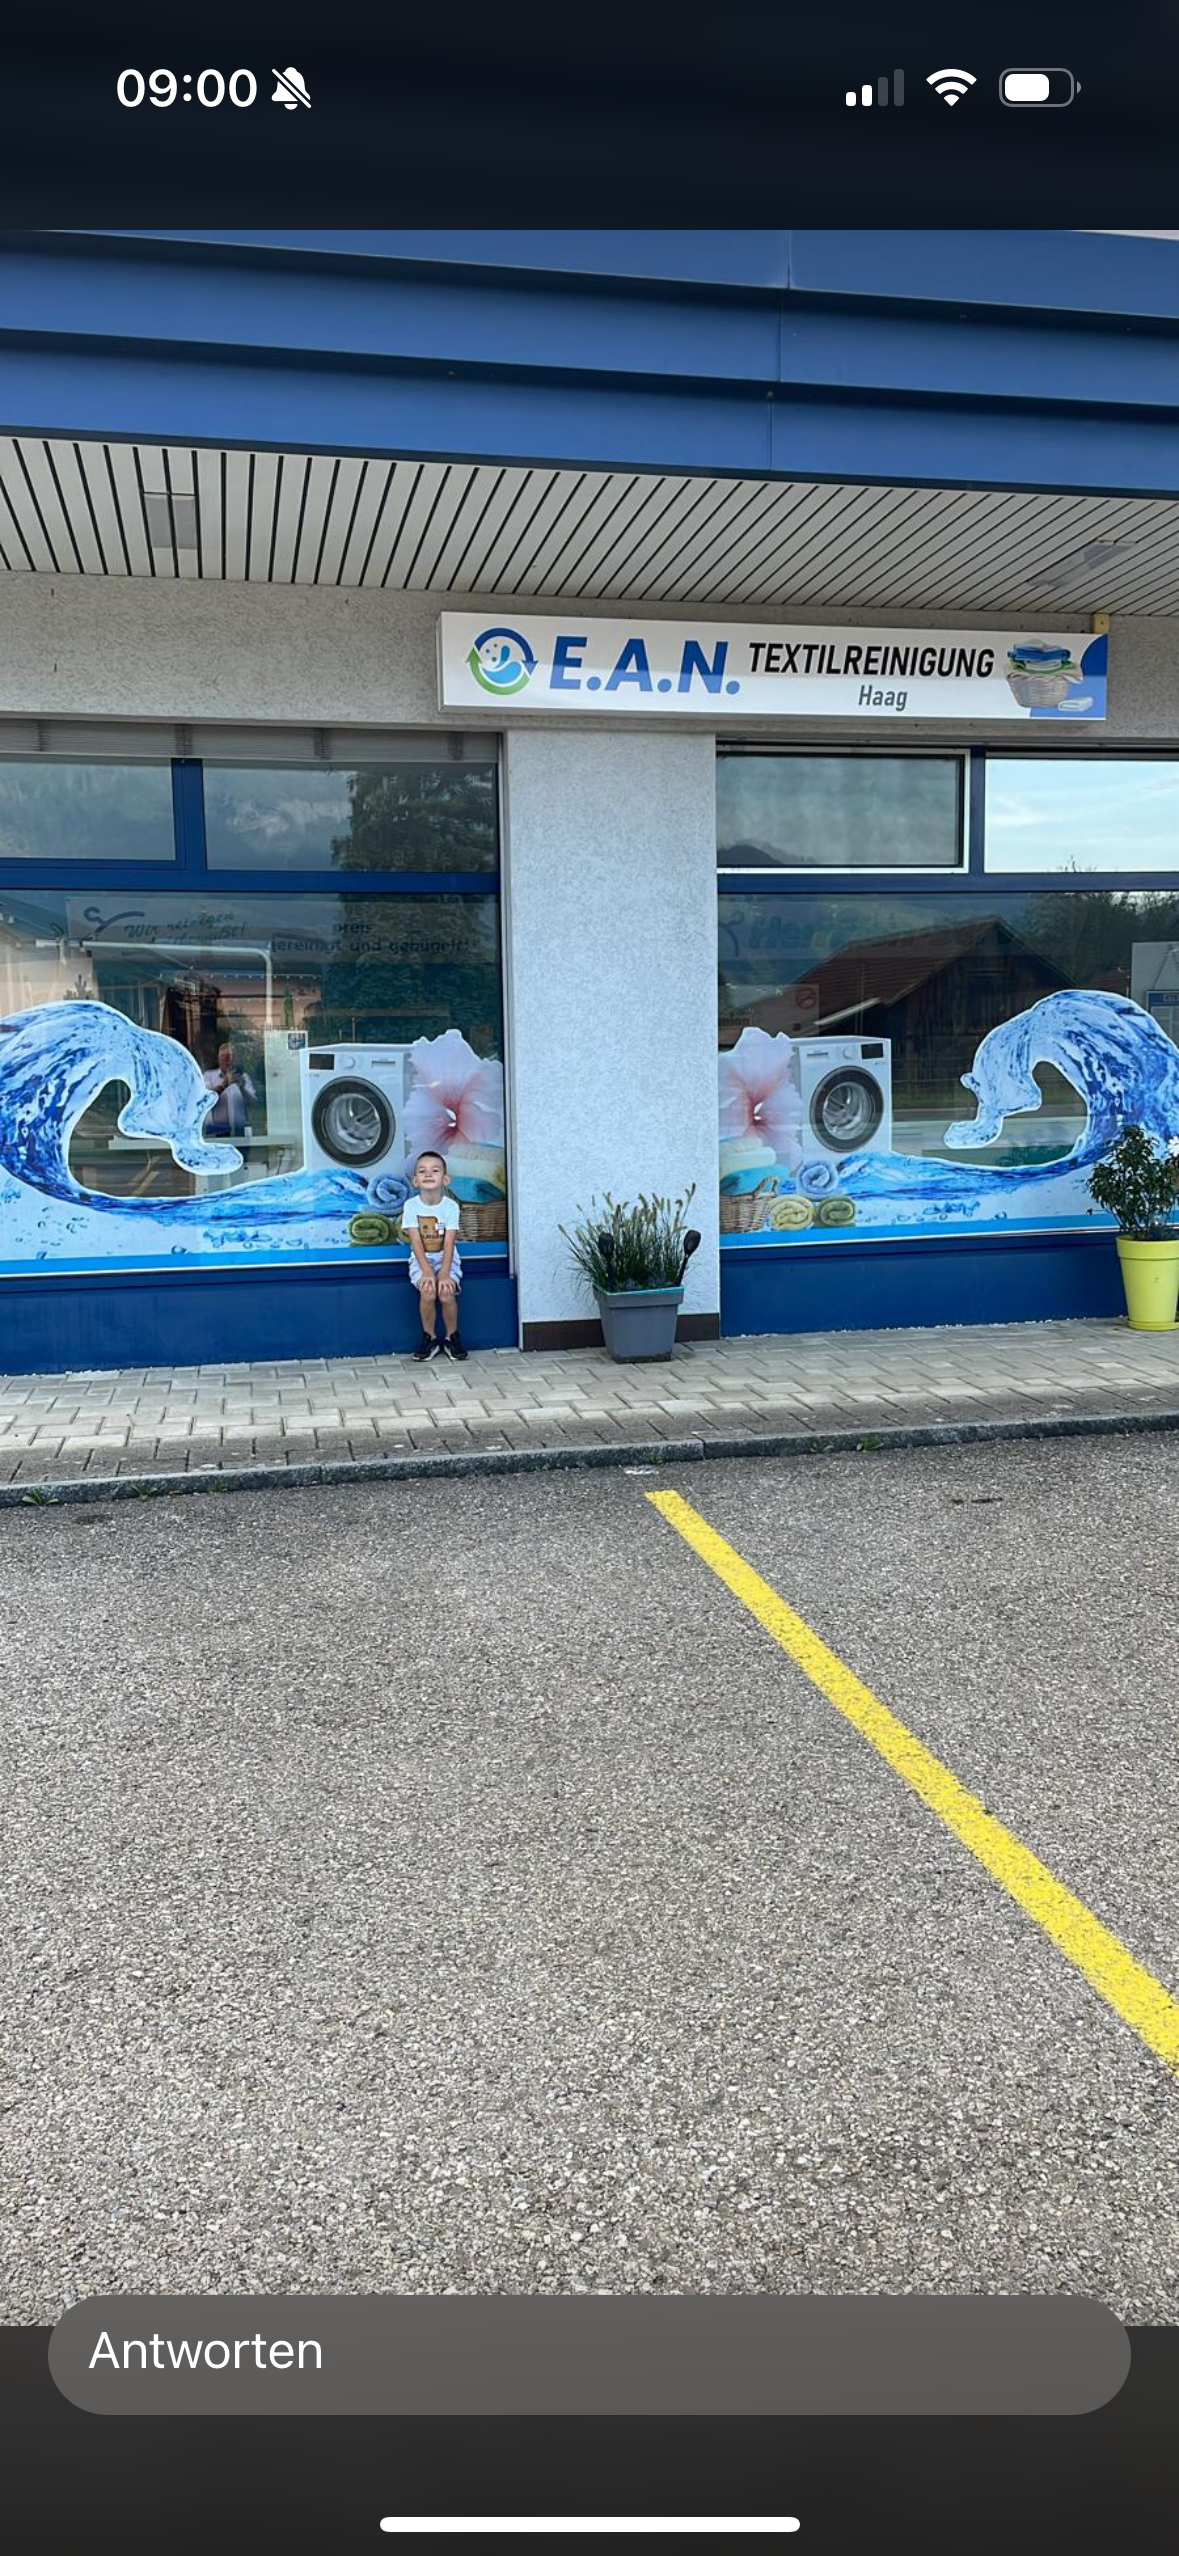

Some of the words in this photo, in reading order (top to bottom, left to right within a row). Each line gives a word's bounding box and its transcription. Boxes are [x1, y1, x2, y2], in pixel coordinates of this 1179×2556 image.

[549, 636, 741, 694] E.A.N.
[748, 641, 995, 679] TEXTILREINIGUNG
[858, 684, 908, 712] Haag
